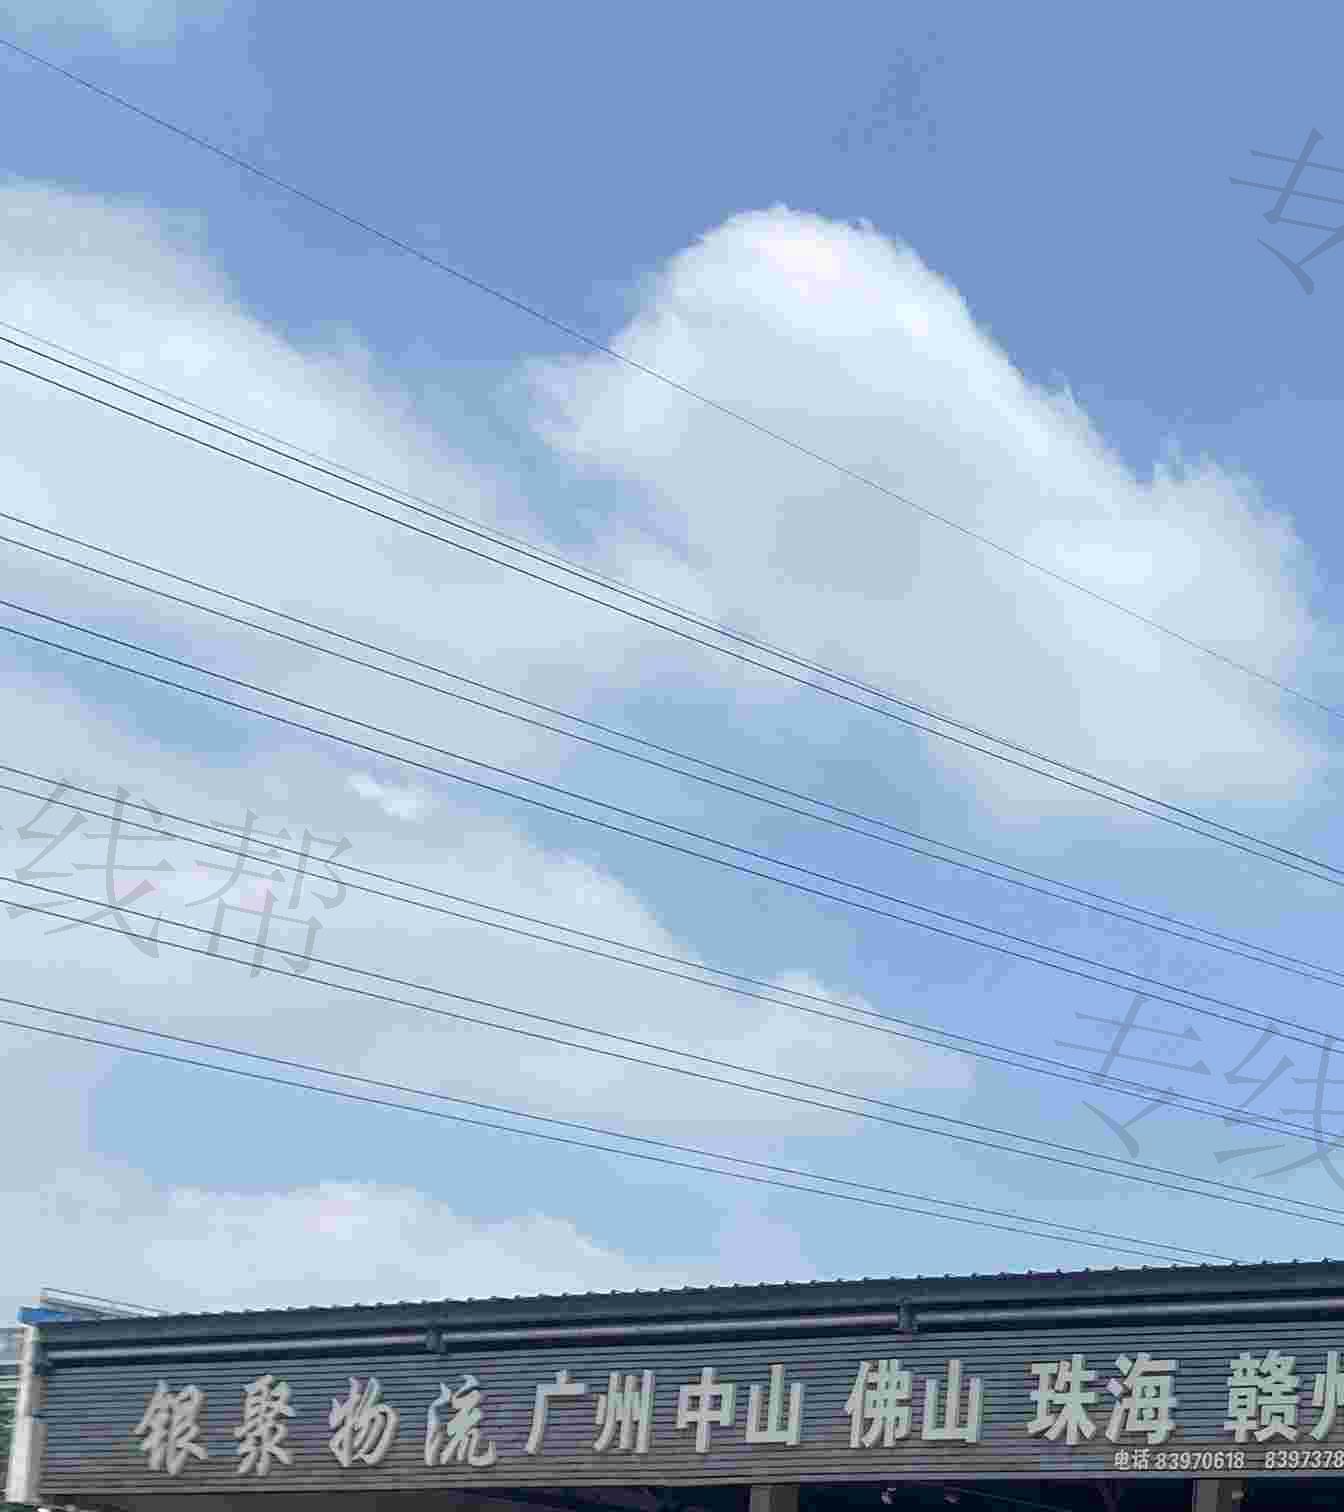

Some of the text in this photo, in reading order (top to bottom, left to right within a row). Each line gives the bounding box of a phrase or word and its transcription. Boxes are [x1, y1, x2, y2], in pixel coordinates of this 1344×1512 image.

[132, 1371, 498, 1478] 银聚物流
[524, 1368, 656, 1456] 广州
[674, 1362, 804, 1455] 中山
[844, 1358, 984, 1448] 佛山
[1025, 1350, 1180, 1447] 珠海
